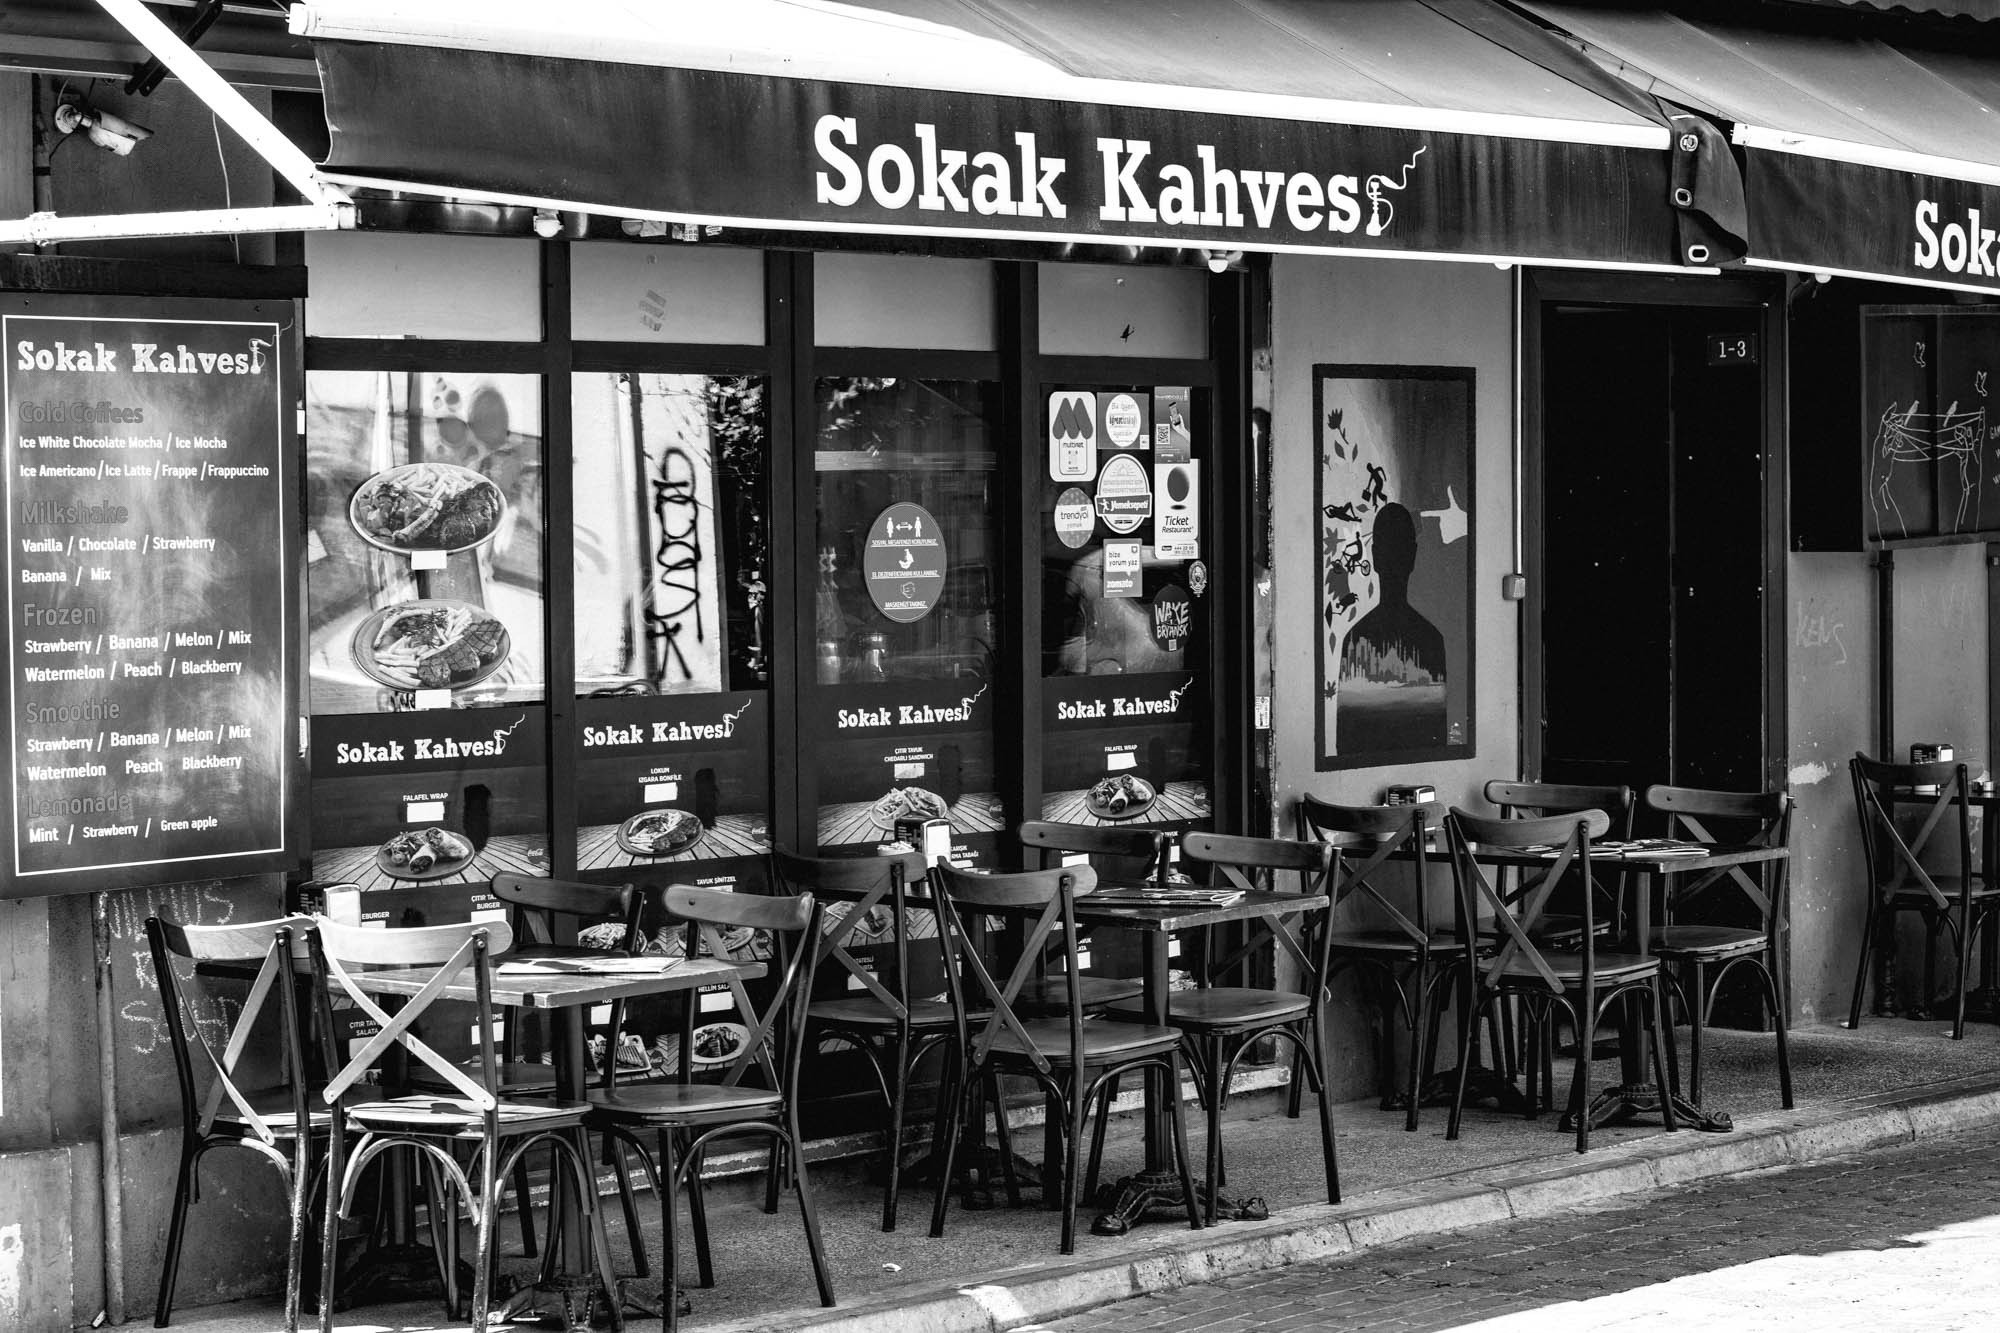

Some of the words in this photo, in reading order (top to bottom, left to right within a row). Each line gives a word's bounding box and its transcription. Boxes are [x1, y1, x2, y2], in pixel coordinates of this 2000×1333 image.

[814, 114, 1066, 219] Sokak
[1914, 200, 2000, 276] Sok
[18, 341, 117, 372] Sokak
[1719, 340, 1746, 358] 1-3
[19, 401, 65, 423] Cold
[70, 401, 144, 423] Coffees
[19, 436, 36, 448] Ice
[38, 436, 70, 448] White
[73, 436, 126, 449] Chocolate
[128, 436, 163, 449] Mocha
[175, 437, 191, 449] Ice
[194, 437, 227, 449] Mocha
[20, 465, 37, 477] Ice
[39, 465, 96, 477] Americano
[105, 465, 122, 477] Ice
[124, 465, 152, 477] Latte
[162, 465, 198, 480] Frappe
[208, 465, 269, 480] Frappuccino
[20, 500, 129, 524] Milkshake
[1165, 516, 1189, 526] Ticket
[22, 539, 63, 552] Vanilla
[79, 538, 137, 551] Chocolate
[153, 537, 215, 551] Strawberry
[22, 570, 67, 583] Banana
[91, 568, 111, 581] Mix
[23, 603, 97, 626] Frozen
[1155, 601, 1189, 625] WAKE
[25, 639, 92, 655] Strawberry
[109, 635, 158, 650] Banana
[175, 633, 213, 647] Melon
[228, 631, 251, 645] Mix
[25, 667, 104, 682] Watermelon
[124, 663, 162, 678] Peach
[181, 660, 242, 675] Blackberry
[26, 699, 120, 724] Smoothie
[838, 707, 891, 728] Sokak
[1058, 700, 1106, 719] Sokak
[27, 738, 93, 753] Strawberry
[110, 732, 160, 747] Banana
[176, 728, 213, 743] Melon
[229, 725, 251, 739] Mix
[583, 724, 643, 747] Sokak
[337, 741, 404, 764] Sokak
[27, 765, 106, 781] Watermelon
[125, 759, 163, 774] Peach
[182, 755, 242, 770] Blackberry
[27, 790, 131, 818] Lemonade
[403, 793, 429, 801] FALAFEL
[430, 792, 448, 800] WRAP
[29, 827, 59, 843] Mint
[82, 823, 138, 838] Strawberry
[160, 819, 188, 832] Green
[191, 816, 218, 831] apple
[477, 902, 500, 910] BURGER
